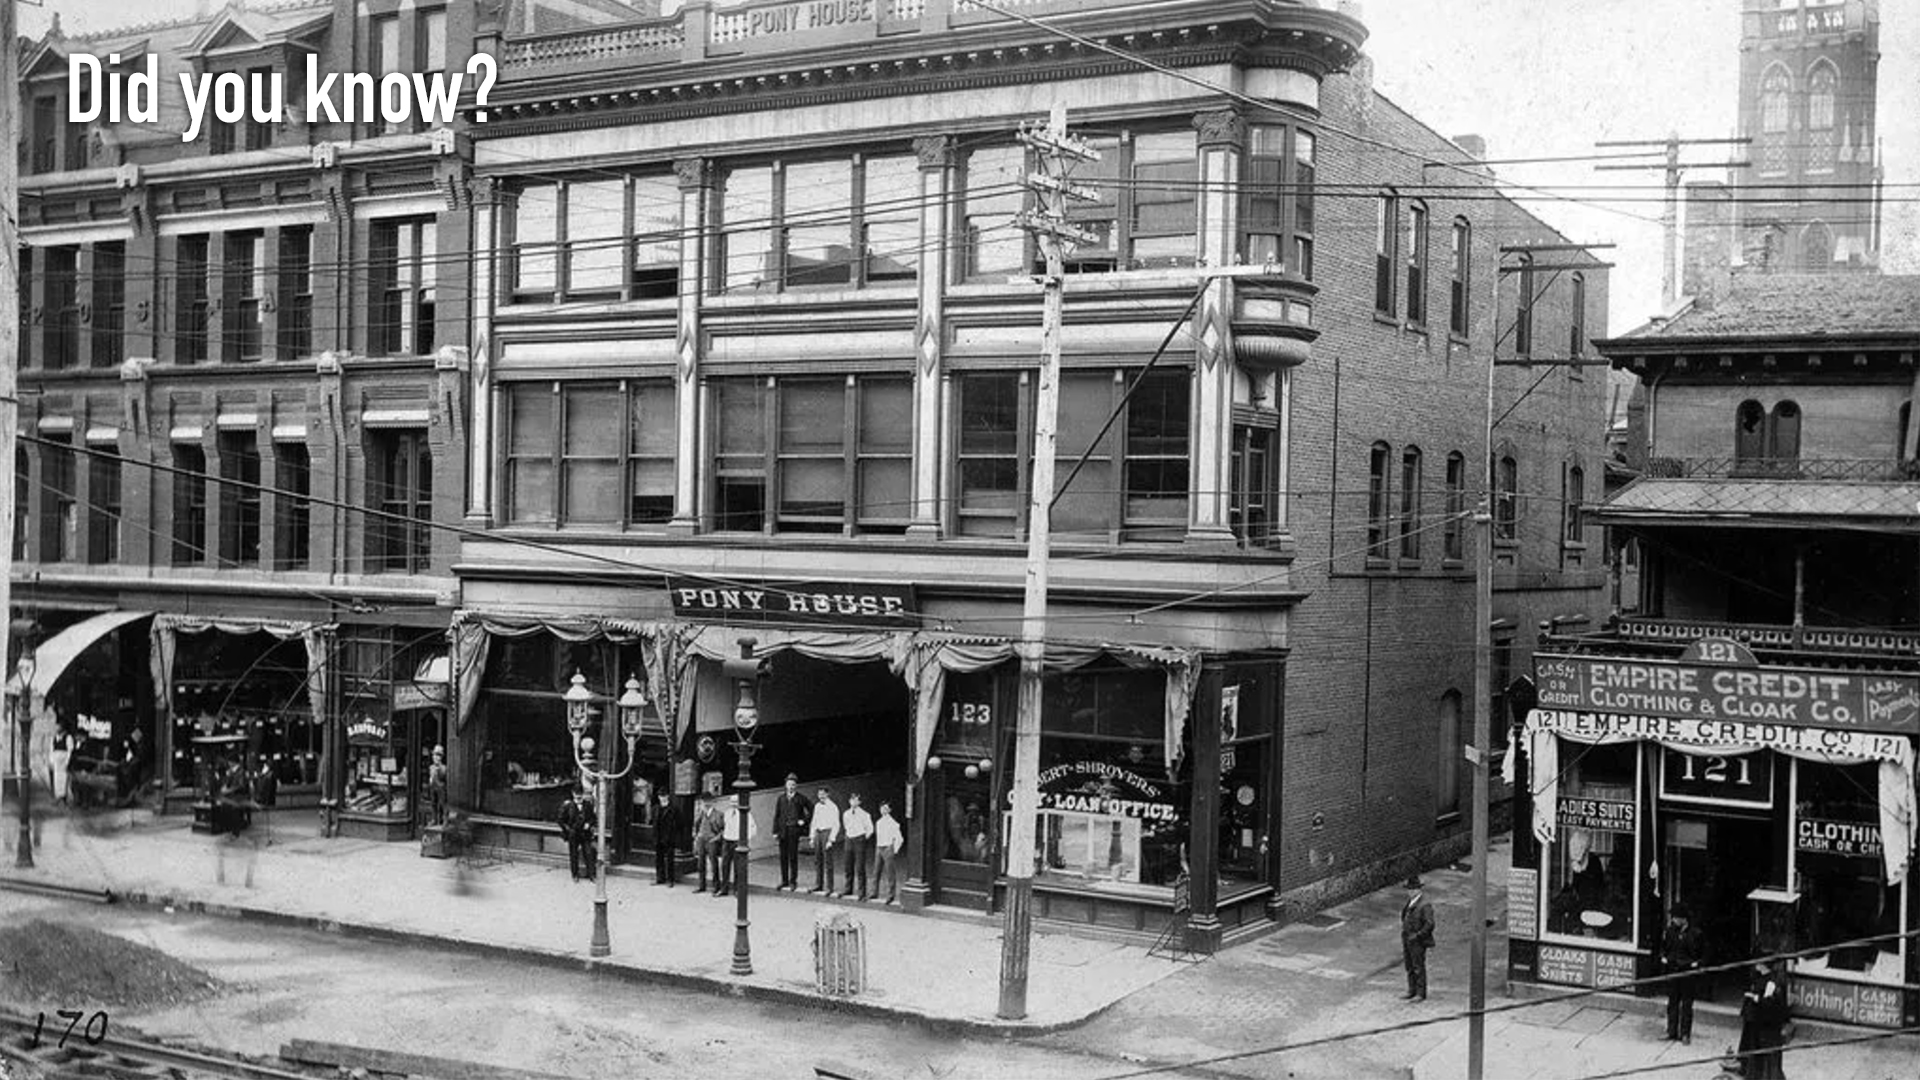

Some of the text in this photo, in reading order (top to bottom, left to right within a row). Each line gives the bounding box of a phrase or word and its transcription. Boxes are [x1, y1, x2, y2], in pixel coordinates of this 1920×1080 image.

[751, 0, 873, 35] PONY HOUSE
[678, 588, 904, 617] PONY HOUSE
[1699, 643, 1738, 662] 121
[1550, 681, 1567, 691] OR
[1590, 664, 1850, 701] EMPIRE CREDIT
[1538, 688, 1580, 706] CREDIT
[1699, 698, 1715, 715] &
[951, 702, 991, 723] 123
[1538, 712, 1561, 727] 121
[1576, 713, 1682, 736] EMPIRE
[1697, 719, 1806, 744] CREDIT
[1874, 738, 1901, 755] 121
[1681, 755, 1753, 785] 121
[1054, 794, 1101, 813] LOAN
[1599, 803, 1634, 820] SUITS
[1799, 838, 1829, 850] CASH
[1837, 841, 1853, 852] OR
[33, 1010, 108, 1049] 170
